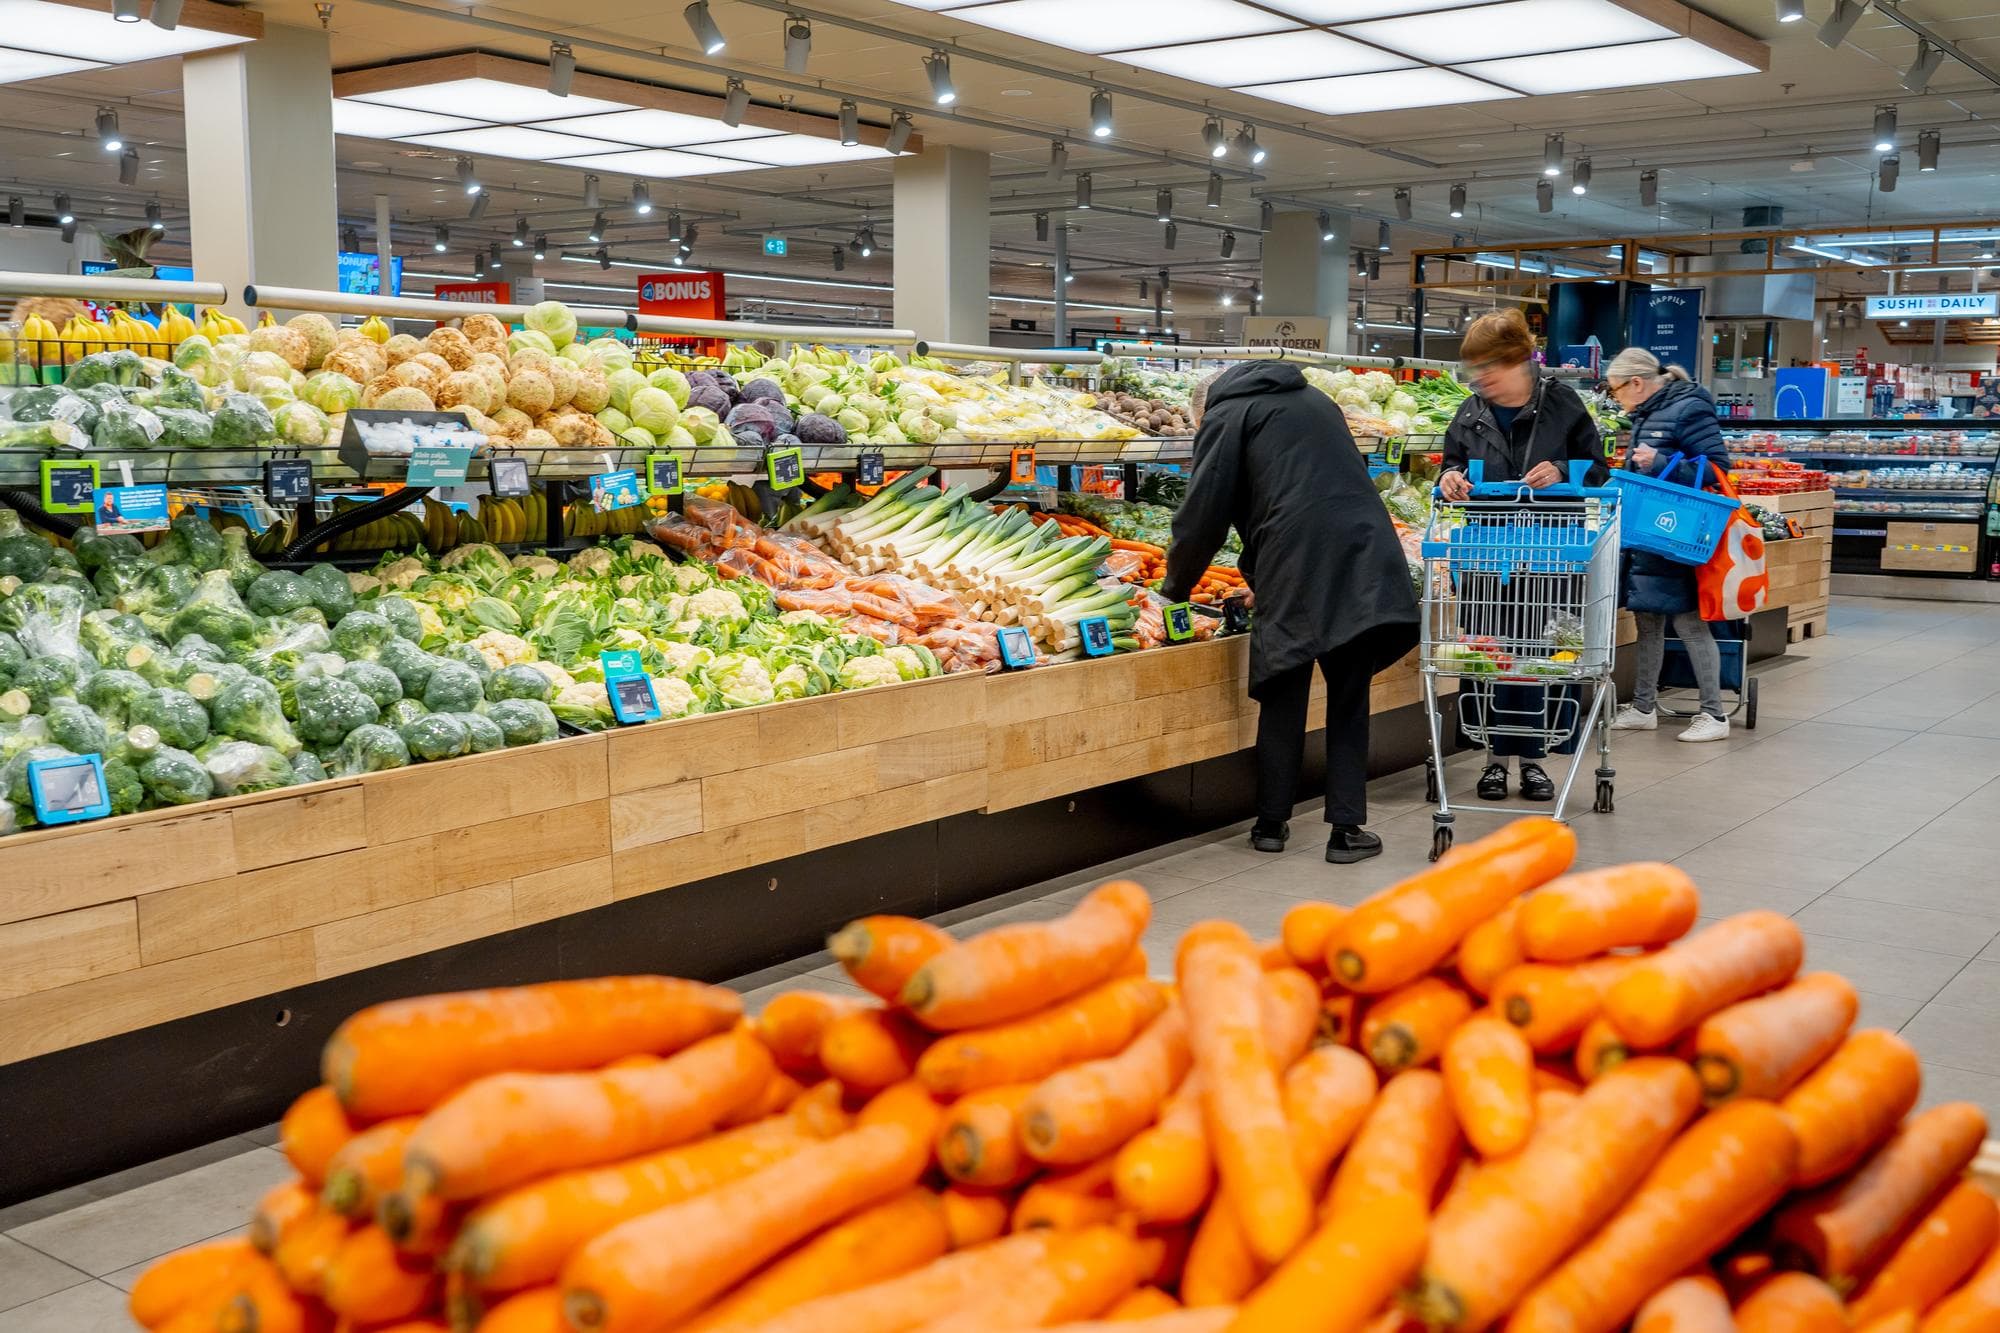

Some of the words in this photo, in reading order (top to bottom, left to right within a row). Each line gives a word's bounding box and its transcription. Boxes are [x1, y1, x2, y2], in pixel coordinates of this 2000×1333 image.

[450, 290, 496, 304] BONUS
[655, 281, 711, 301] BONUS
[1649, 295, 1686, 308] HAPPILY
[1878, 299, 1923, 309] SUSHI
[1941, 297, 1986, 308] DAILY
[1281, 339, 1320, 350] KOEKEN
